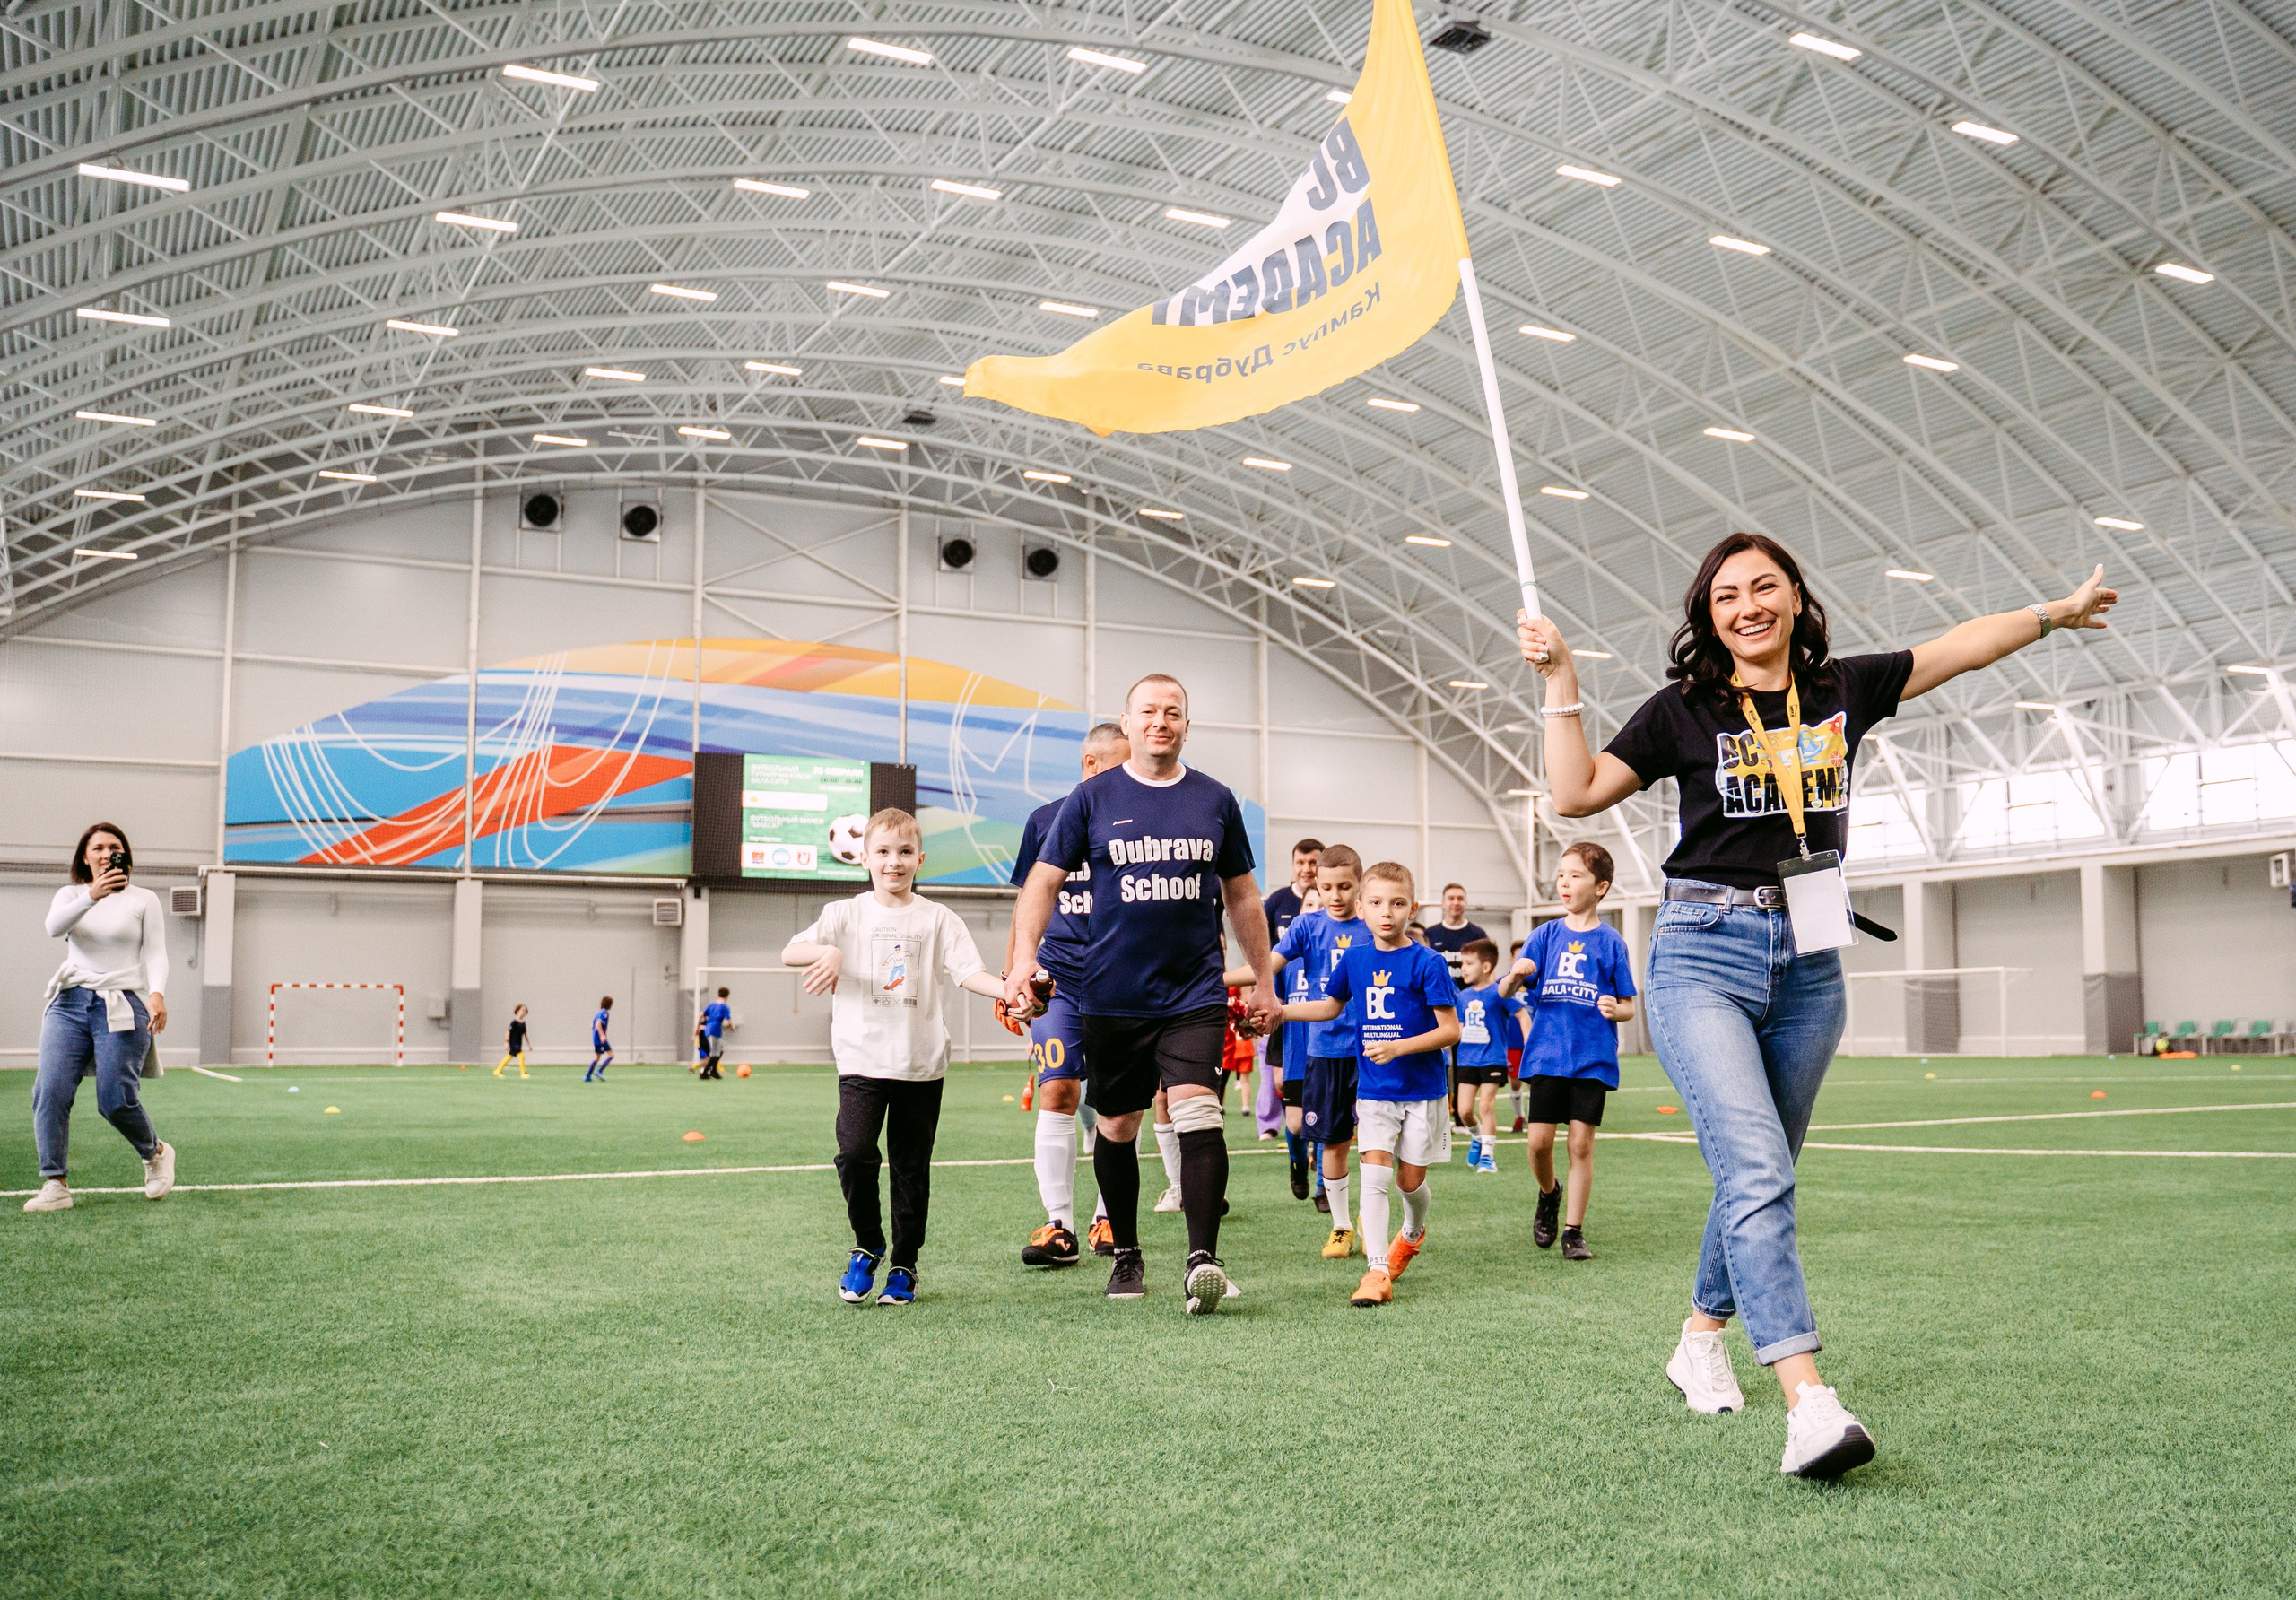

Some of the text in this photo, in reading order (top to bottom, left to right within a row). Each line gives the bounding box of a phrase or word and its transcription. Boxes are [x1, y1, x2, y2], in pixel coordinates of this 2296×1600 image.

[1719, 733, 1759, 769] BC
[1726, 766, 1845, 814] ACAEM
[1109, 836, 1213, 865] Dubrava
[1121, 874, 1202, 903] School
[1558, 952, 1587, 979] BC
[1366, 987, 1396, 1020] BC
[1034, 1038, 1065, 1074] 30
